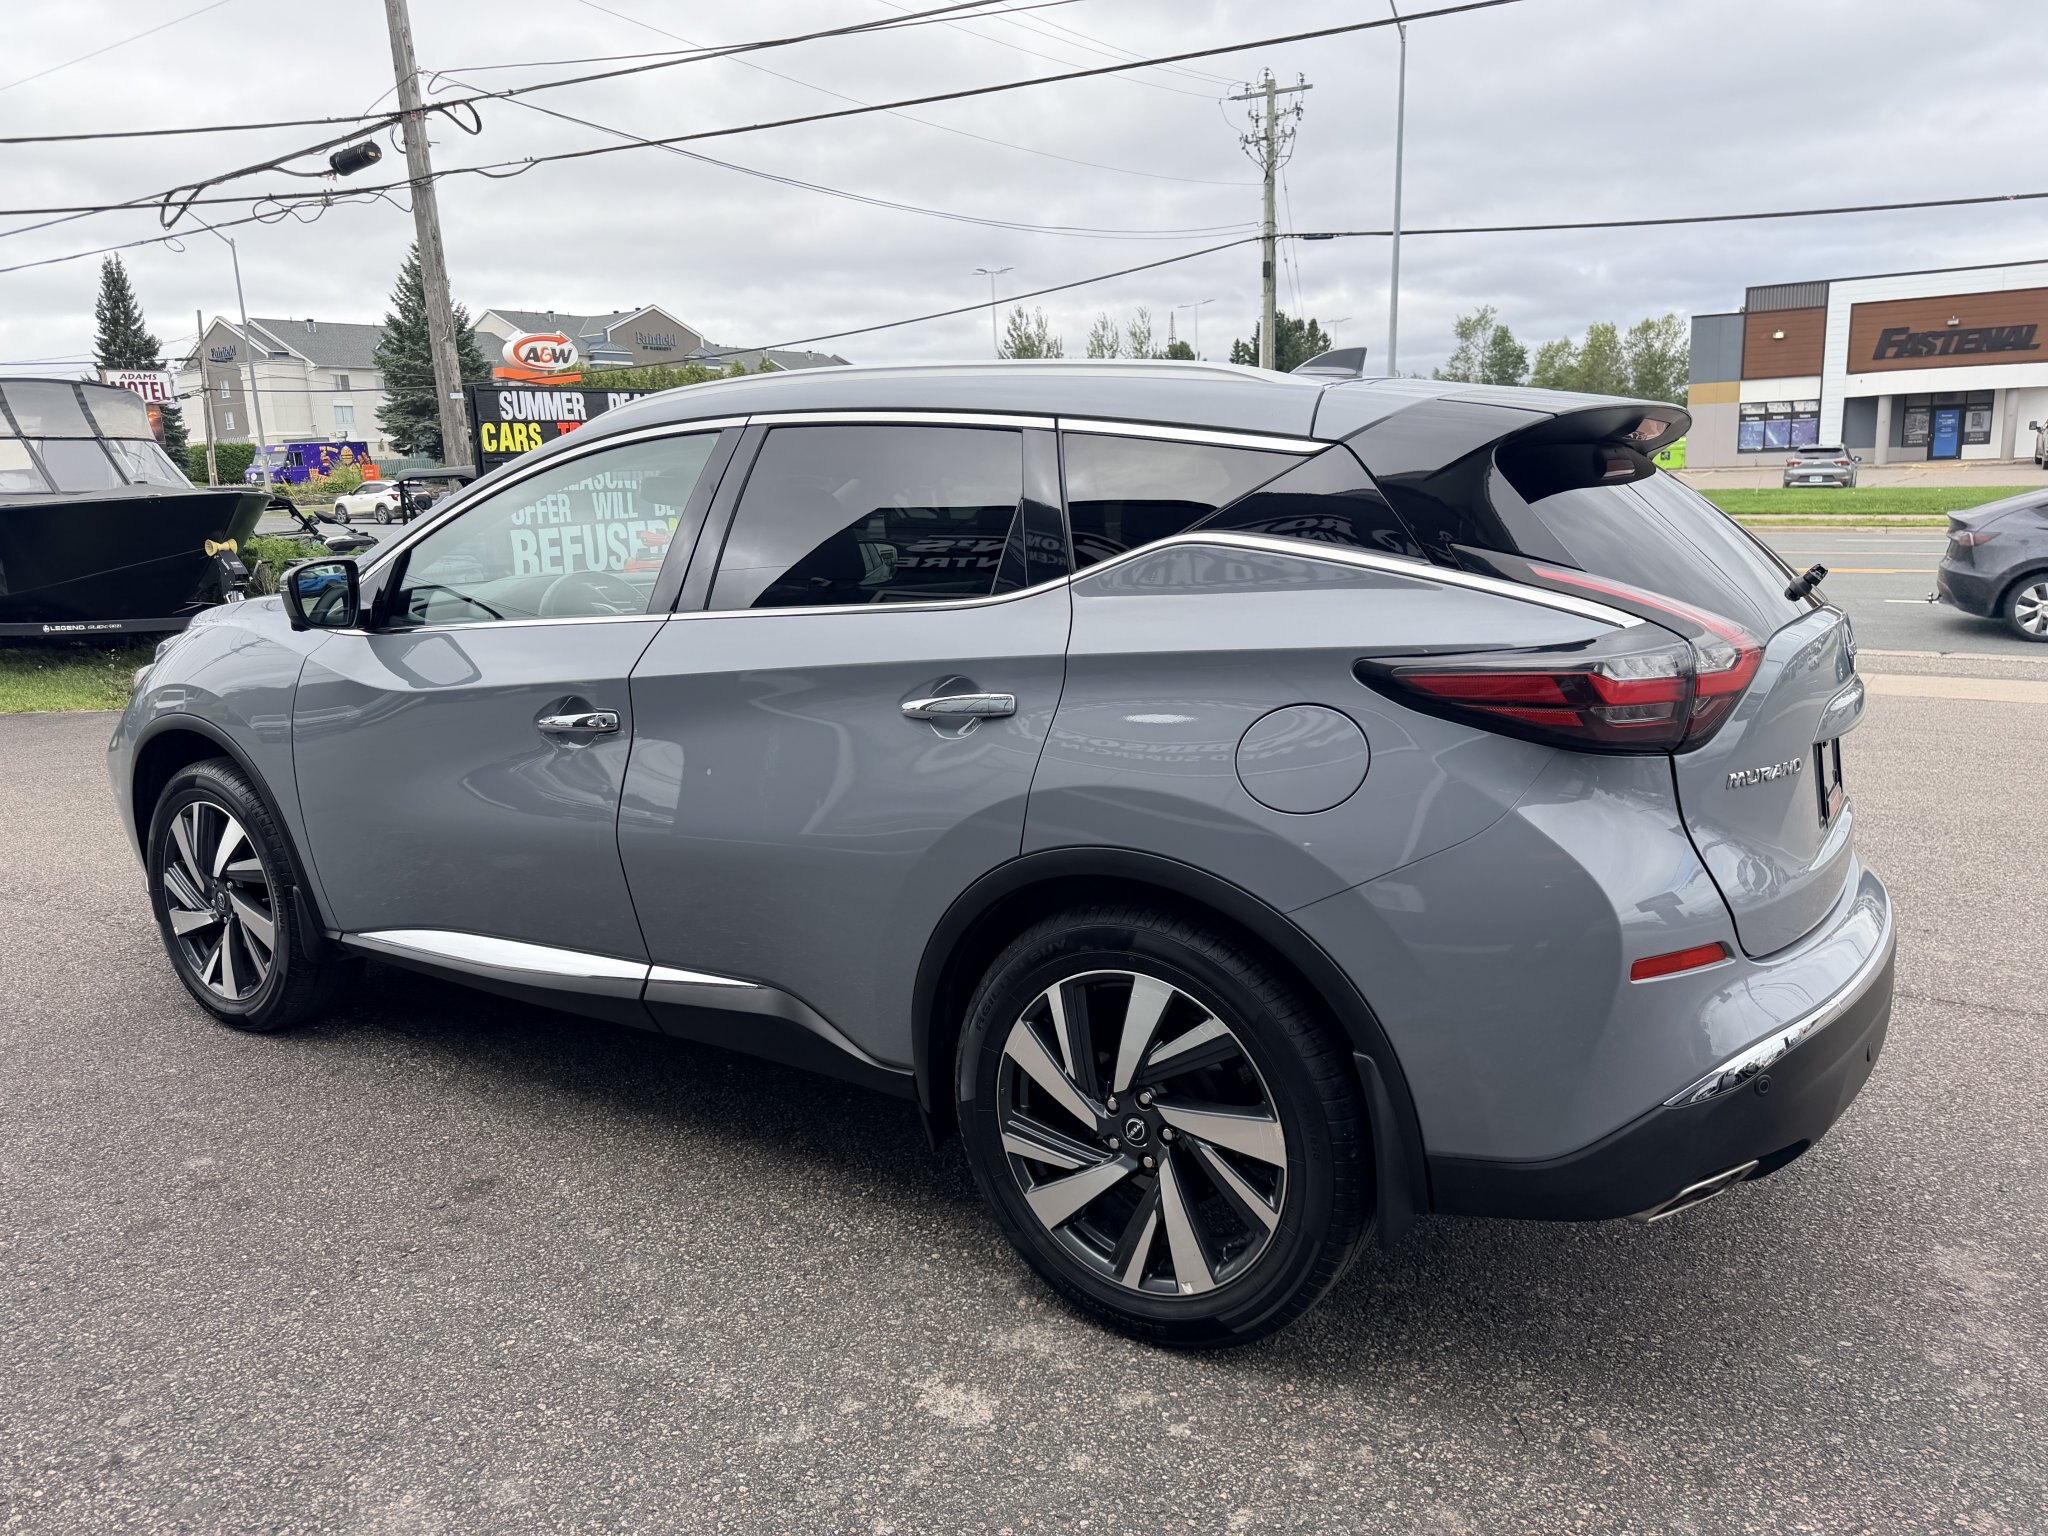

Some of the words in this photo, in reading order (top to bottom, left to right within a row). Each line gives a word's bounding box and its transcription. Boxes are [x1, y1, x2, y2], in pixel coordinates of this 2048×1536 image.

[636, 331, 677, 346] Fairfield
[523, 346, 573, 363] A&W
[499, 391, 588, 421] SUMMER
[481, 422, 543, 452] CARS
[592, 491, 638, 520] WILL
[50, 624, 86, 632] LEGEND
[1726, 757, 1802, 790] MURANO
